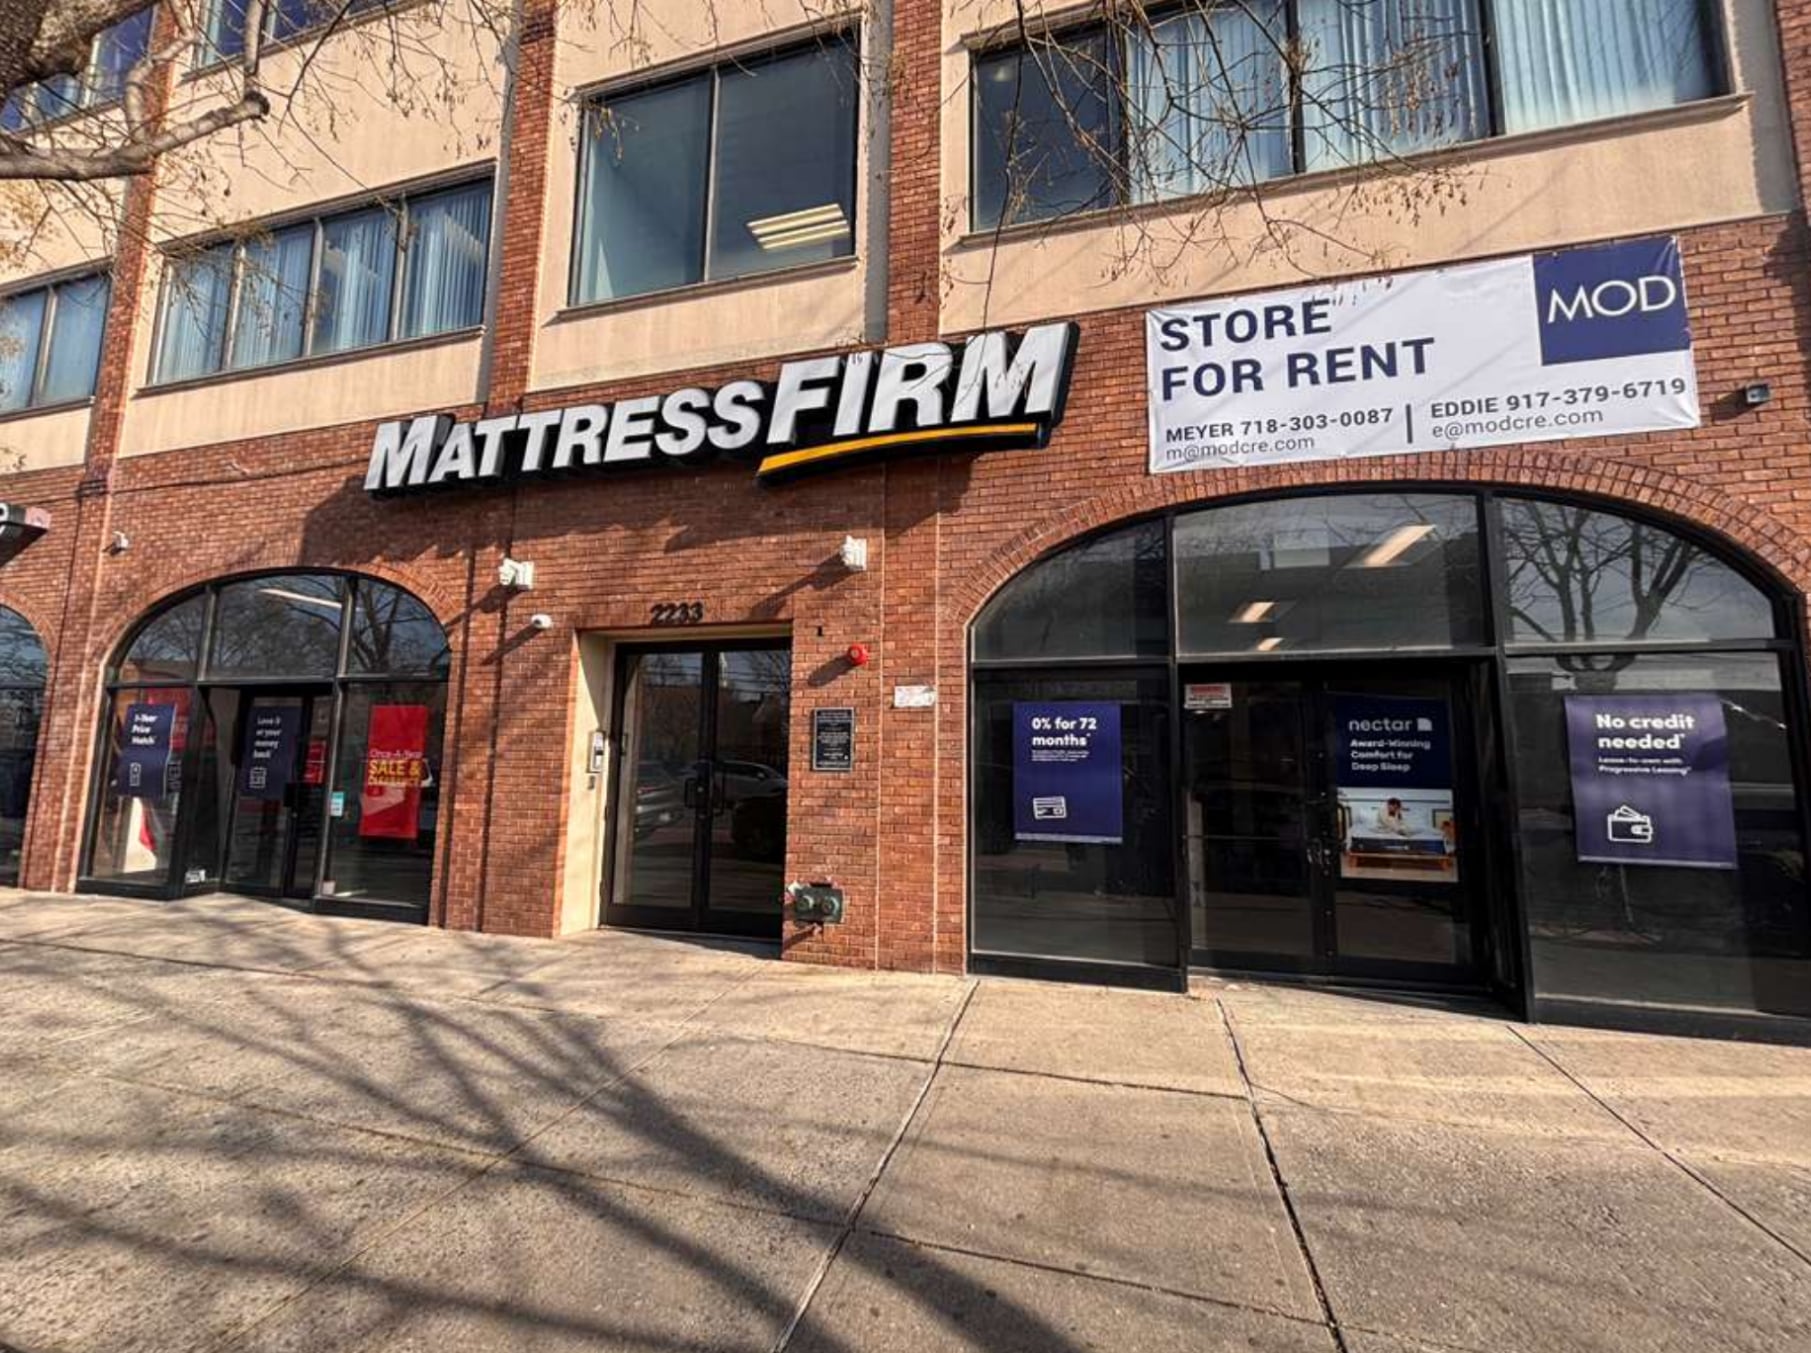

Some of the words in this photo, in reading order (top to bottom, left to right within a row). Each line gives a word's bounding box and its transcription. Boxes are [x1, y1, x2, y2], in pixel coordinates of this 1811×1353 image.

[1548, 276, 1676, 324] MOD
[1160, 298, 1332, 351] STORE
[1162, 359, 1264, 401] FOR
[1287, 337, 1435, 388] RENT
[1431, 397, 1498, 418] EDDIE
[1506, 378, 1686, 411] 917-379-6719
[1166, 423, 1234, 443] MEYER
[1241, 408, 1393, 436] 718-303-0087
[1432, 408, 1604, 441] e@modcre.com
[1166, 435, 1315, 462] m@modcre.com
[650, 601, 704, 626] 2233
[1031, 717, 1052, 730] 0%
[1055, 716, 1077, 730] for
[1079, 717, 1097, 730] 72
[1348, 717, 1413, 732] nectar
[1595, 713, 1626, 729] No
[1629, 713, 1695, 730] credit
[368, 759, 405, 776] SALE
[409, 760, 420, 776] &
